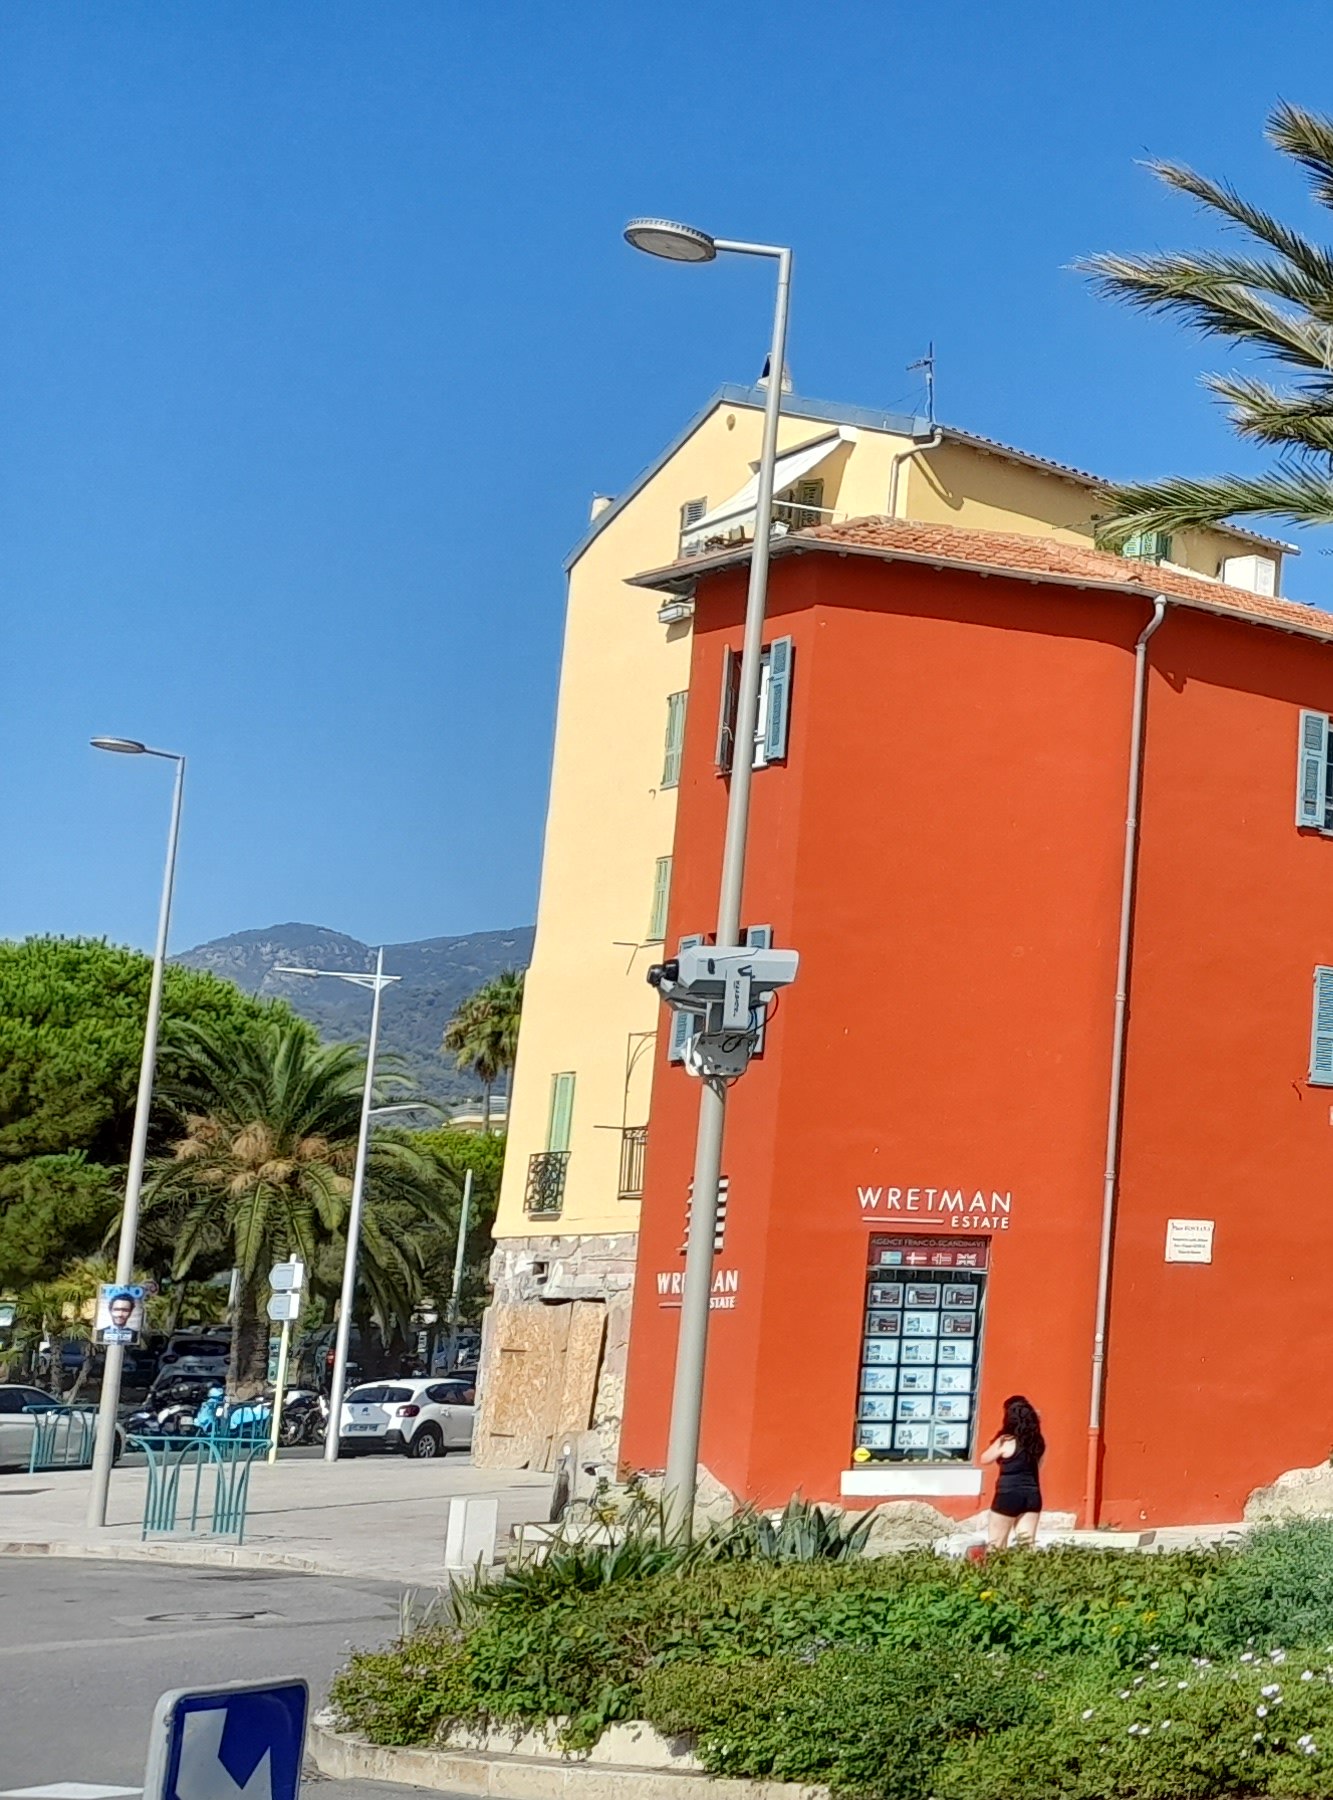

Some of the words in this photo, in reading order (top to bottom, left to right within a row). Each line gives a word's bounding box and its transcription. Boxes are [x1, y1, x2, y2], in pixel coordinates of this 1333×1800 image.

[857, 1186, 1011, 1213] WRETMAN
[951, 1215, 1009, 1229] ESTATE
[871, 1238, 903, 1246] AGENCE
[657, 1270, 738, 1294] WRAN
[709, 1296, 735, 1309] STATE
